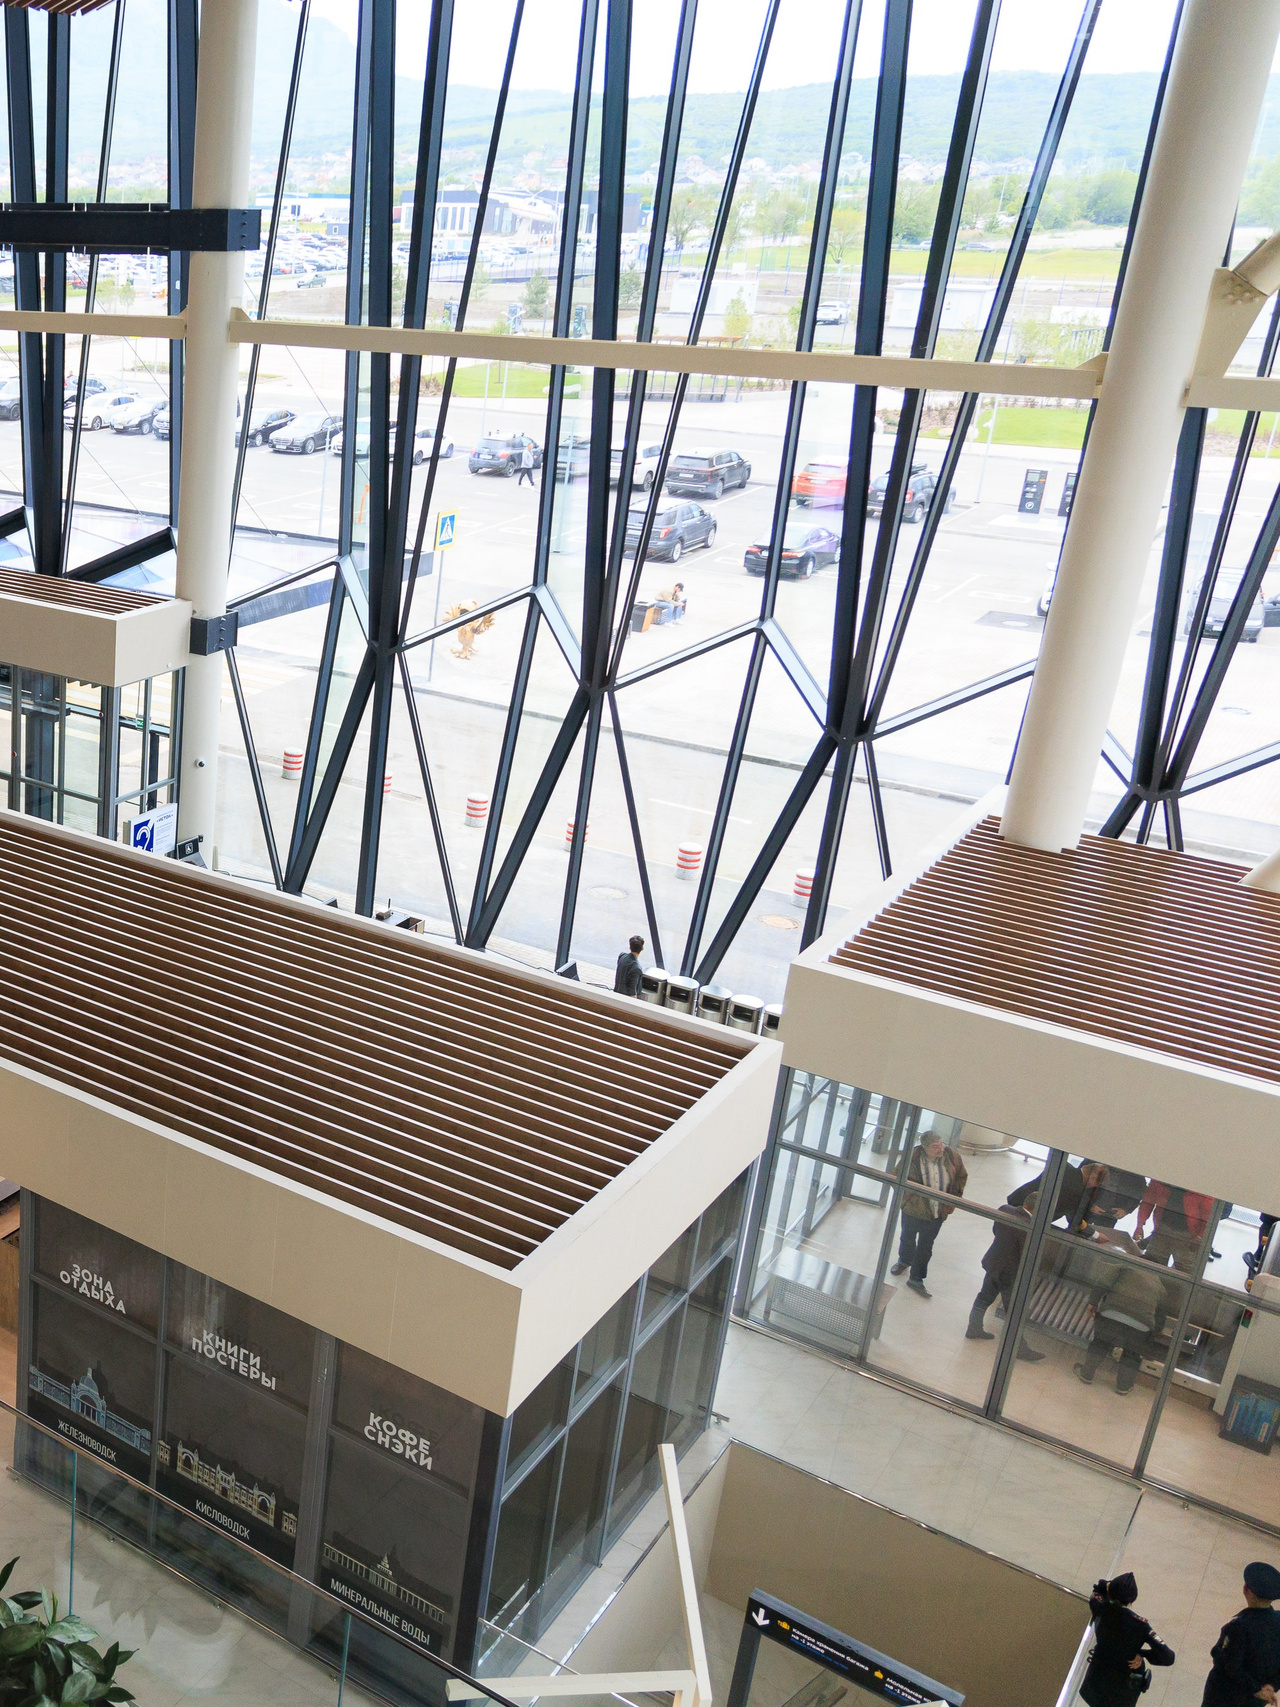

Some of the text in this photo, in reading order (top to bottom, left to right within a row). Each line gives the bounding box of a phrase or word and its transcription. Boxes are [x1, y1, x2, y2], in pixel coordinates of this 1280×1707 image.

[60, 1270, 126, 1314] ОТДЫХА
[72, 1263, 114, 1296] ЗОНА
[192, 1337, 276, 1391] ПОСТЕРЫ
[202, 1329, 261, 1370] КНИГИ
[58, 1419, 117, 1462] ЖЕЛЕЗНОВОДСК
[363, 1425, 433, 1471] СНЭКИ
[369, 1412, 431, 1455] КОФЕ
[195, 1499, 251, 1540] КИСЛОВОДСК
[330, 1578, 431, 1646] МИНЕРАЛЬНЫЕ ВОДЫ
[791, 1633, 800, 1641] на
[792, 1628, 816, 1643] Камера
[816, 1640, 846, 1659] хранения
[846, 1656, 869, 1671] багажа
